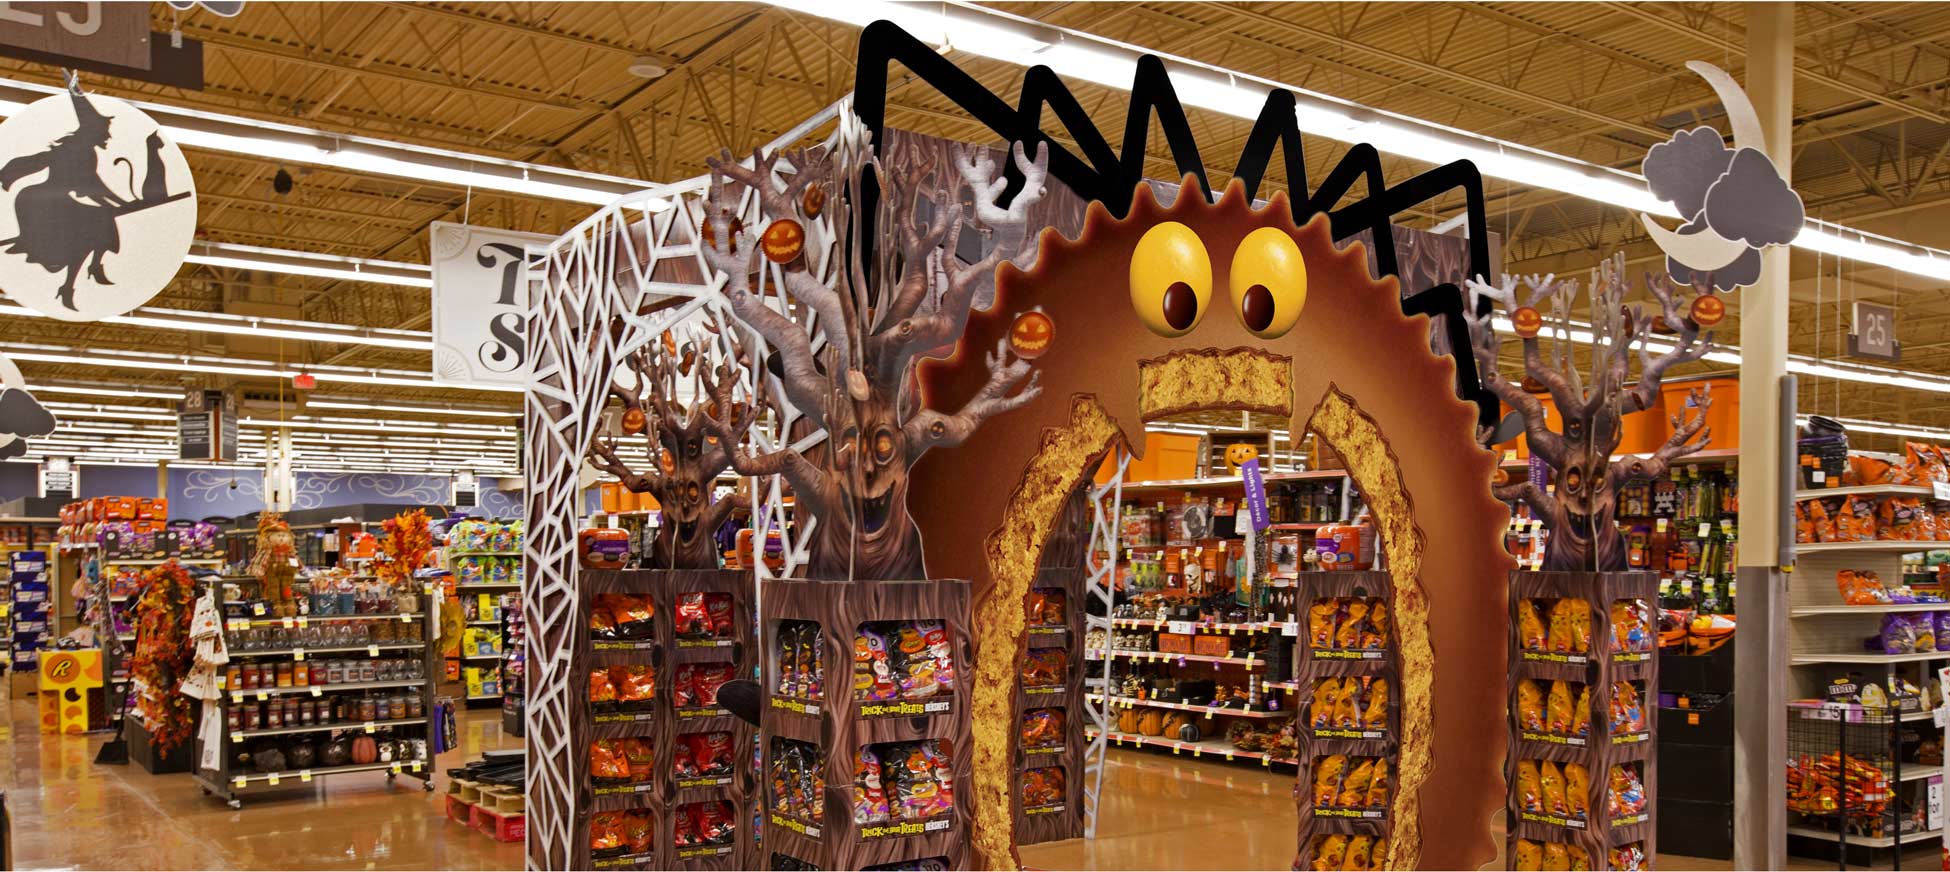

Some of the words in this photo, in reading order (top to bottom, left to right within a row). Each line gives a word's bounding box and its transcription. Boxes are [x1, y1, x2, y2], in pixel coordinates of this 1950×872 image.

[1867, 313, 1885, 346] 25
[187, 391, 201, 408] 28
[1247, 468, 1256, 491] Lights
[861, 706, 884, 716] TRICK
[900, 702, 924, 714] TREATS
[861, 827, 884, 838] TRICK
[900, 822, 924, 834] TREATS
